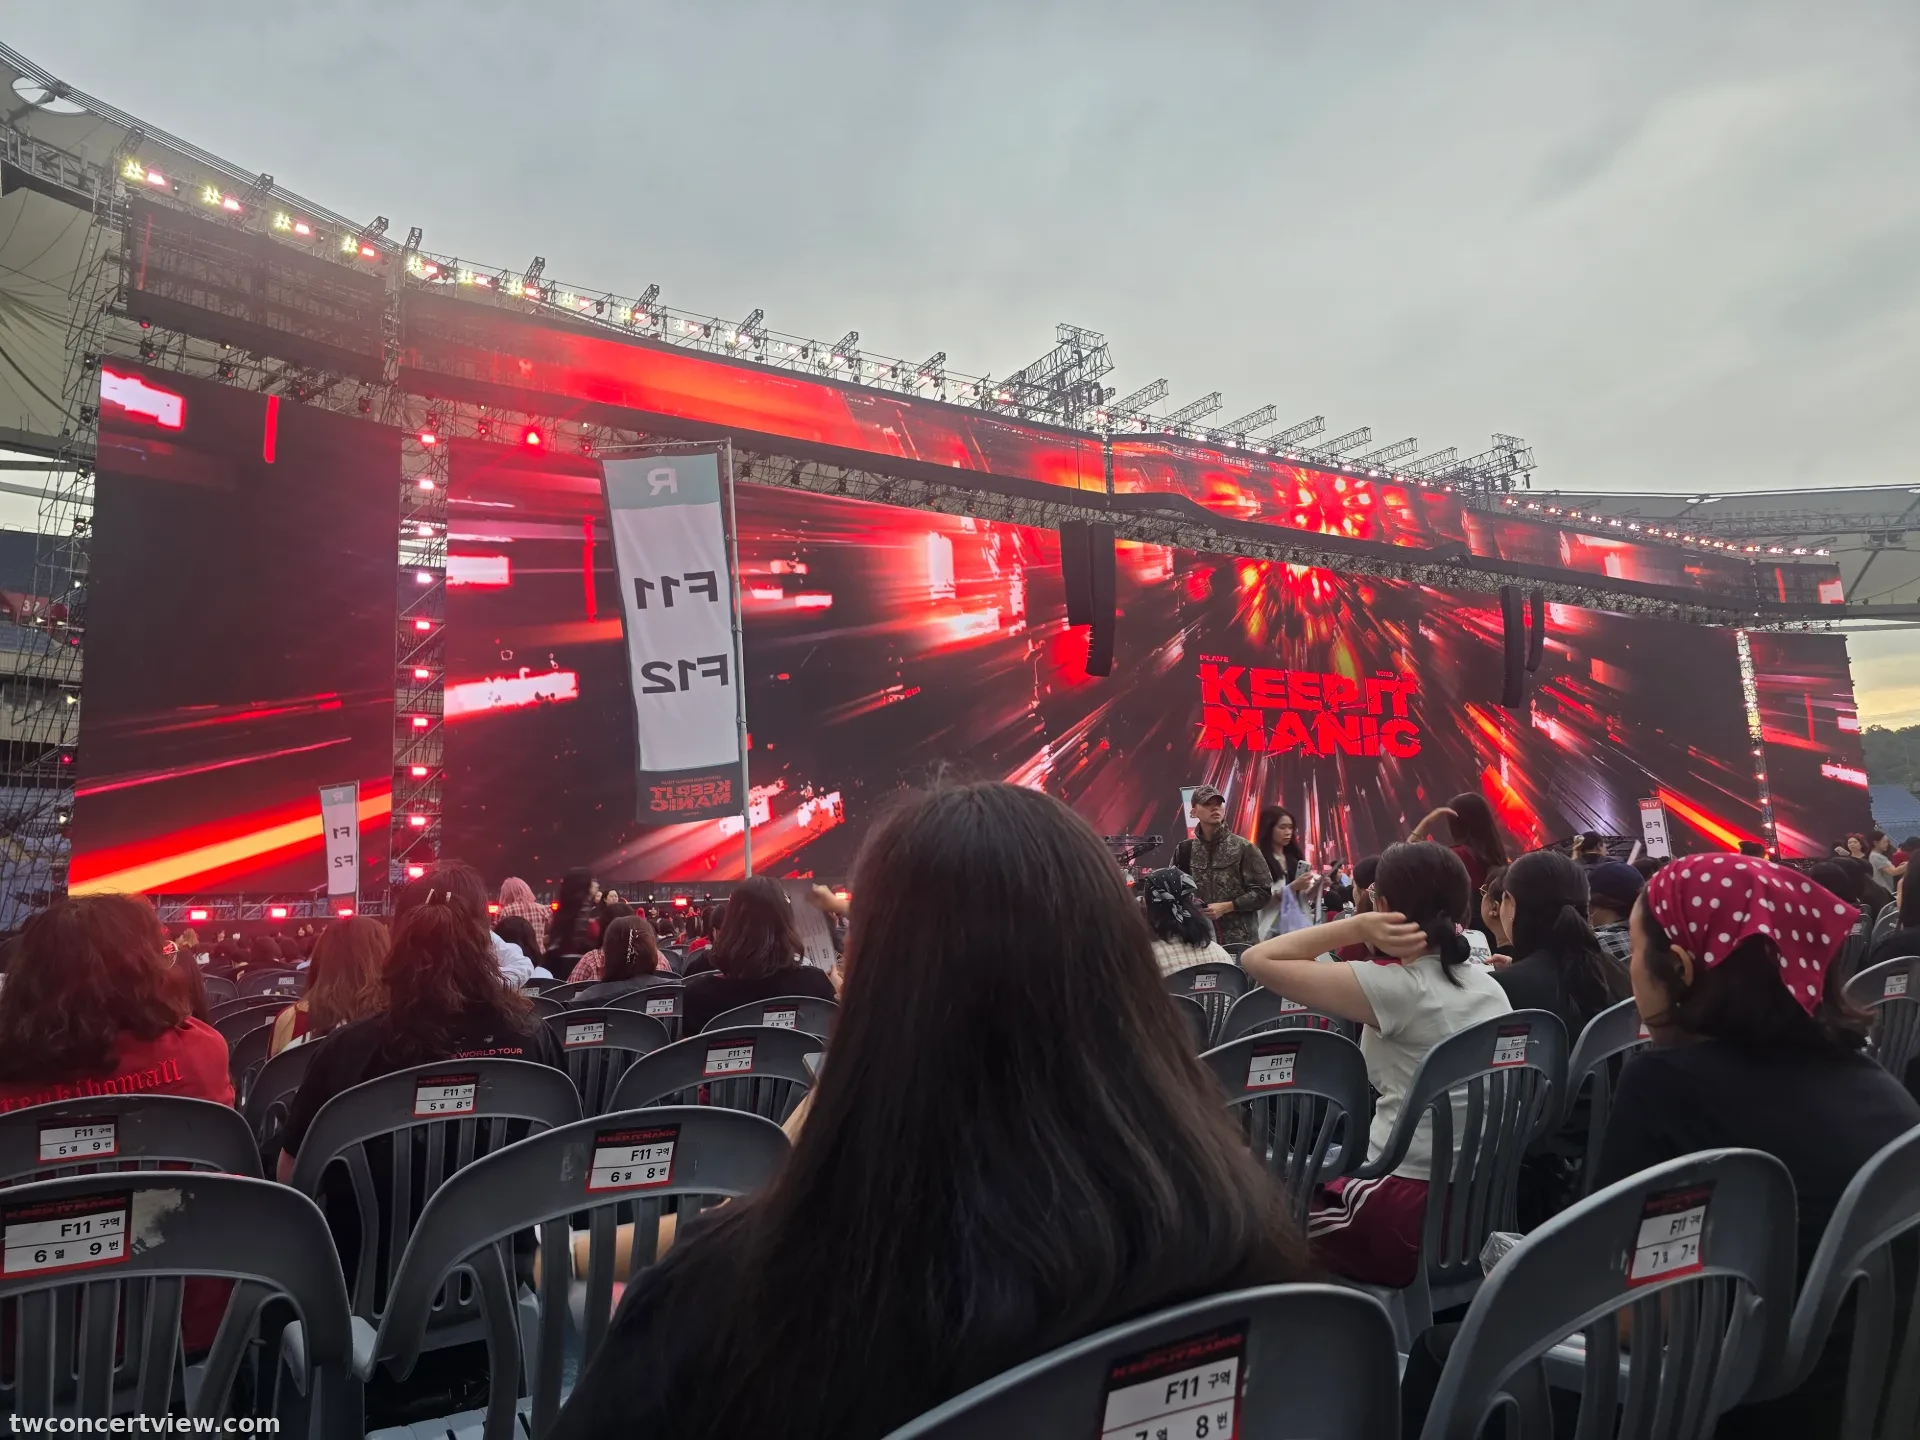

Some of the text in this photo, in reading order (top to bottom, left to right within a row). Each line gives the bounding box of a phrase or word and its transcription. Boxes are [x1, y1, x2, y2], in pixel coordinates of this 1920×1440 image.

[1198, 663, 1416, 717] KEEP IT
[1196, 706, 1422, 759] MANIC
[460, 1049, 496, 1058] WORLD
[497, 1047, 523, 1055] TOUR
[728, 1050, 740, 1058] F11
[717, 1062, 723, 1070] 5
[738, 1060, 743, 1068] 7
[1270, 1057, 1283, 1067] F11
[1260, 1073, 1265, 1083] 6
[1279, 1071, 1285, 1080] 6
[443, 1088, 459, 1097] F11
[430, 1102, 437, 1111] 5
[456, 1101, 463, 1109] 8
[74, 1128, 94, 1138] F11
[59, 1145, 67, 1155] 5
[92, 1141, 100, 1151] 9
[630, 1147, 670, 1162] F11 구역
[611, 1171, 620, 1183] 6
[646, 1167, 655, 1179] 8
[60, 1217, 120, 1237] F11 구역
[1669, 1215, 1687, 1236] F11
[34, 1240, 119, 1263] 6 열 9 번
[1652, 1250, 1659, 1269] 7
[1681, 1243, 1689, 1260] 7
[1165, 1369, 1231, 1404] F11 구역
[1195, 1414, 1209, 1439] 8
[1216, 1411, 1228, 1431] 번
